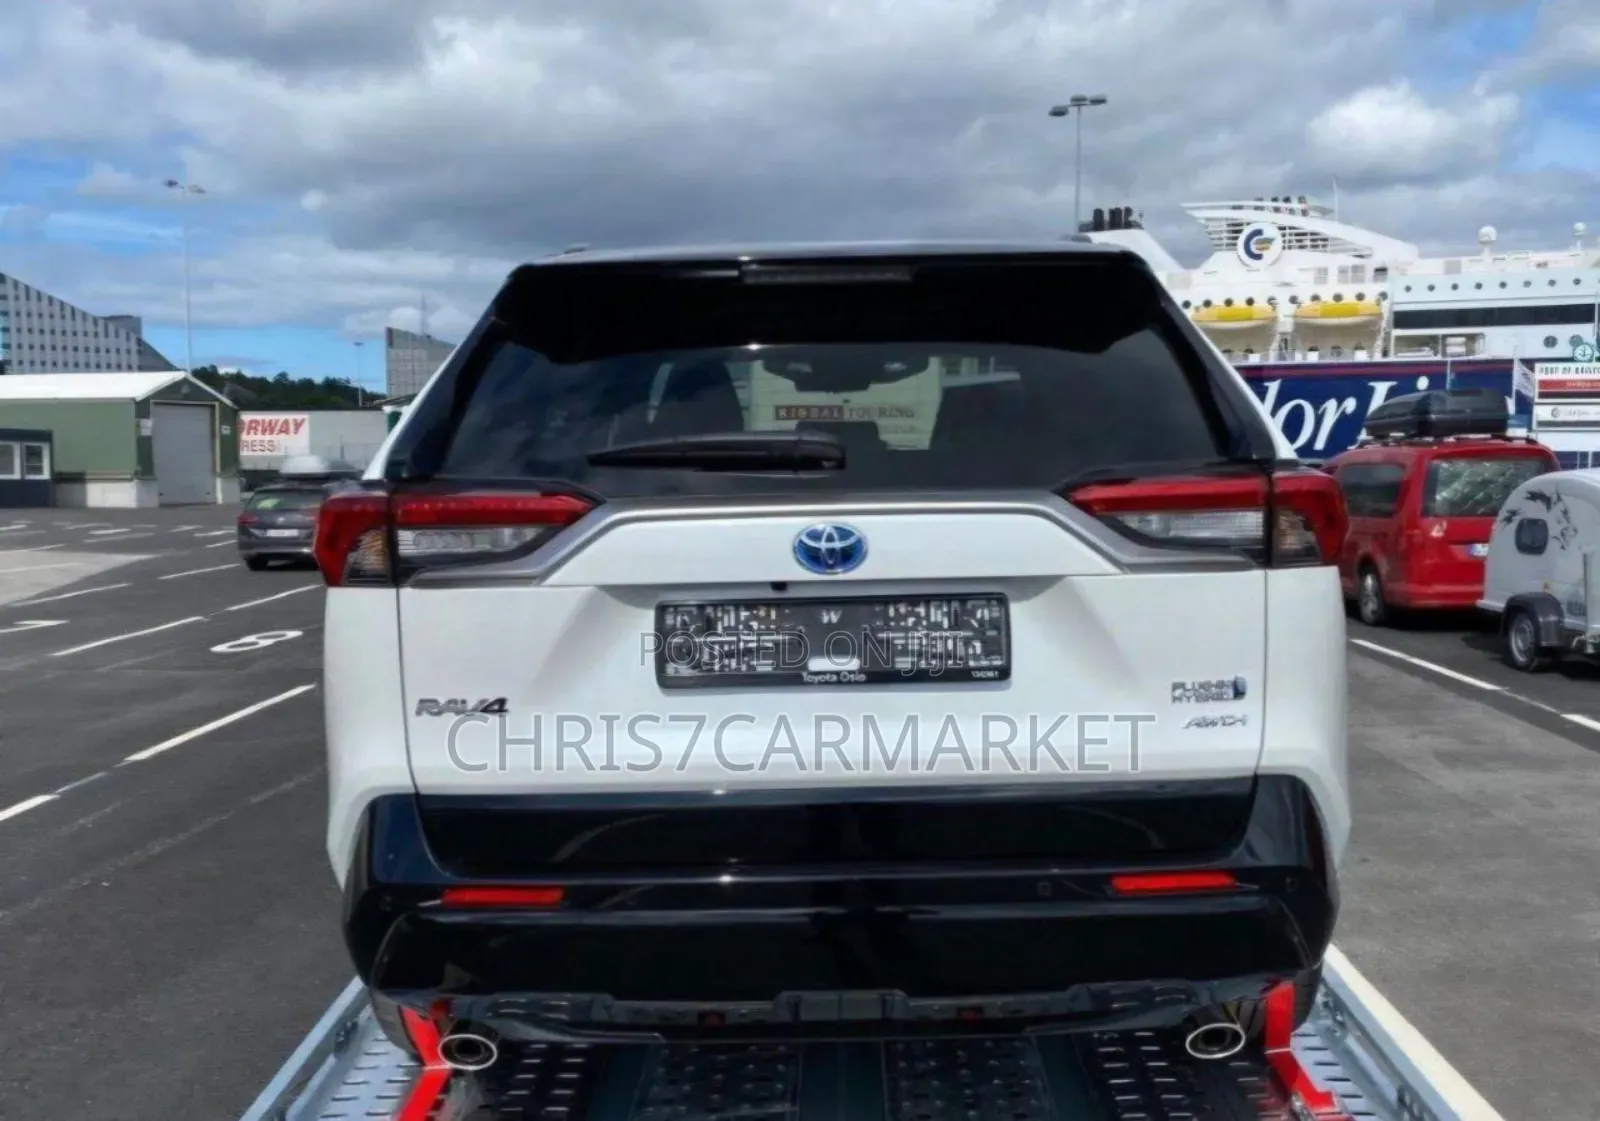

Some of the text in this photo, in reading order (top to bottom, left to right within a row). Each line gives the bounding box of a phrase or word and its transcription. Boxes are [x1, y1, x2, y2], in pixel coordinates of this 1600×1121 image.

[1263, 379, 1357, 451] lor
[237, 418, 306, 436] ORWAY
[240, 440, 277, 452] RESS
[802, 671, 866, 683] Toyota Oslo
[415, 698, 509, 717] RAV4
